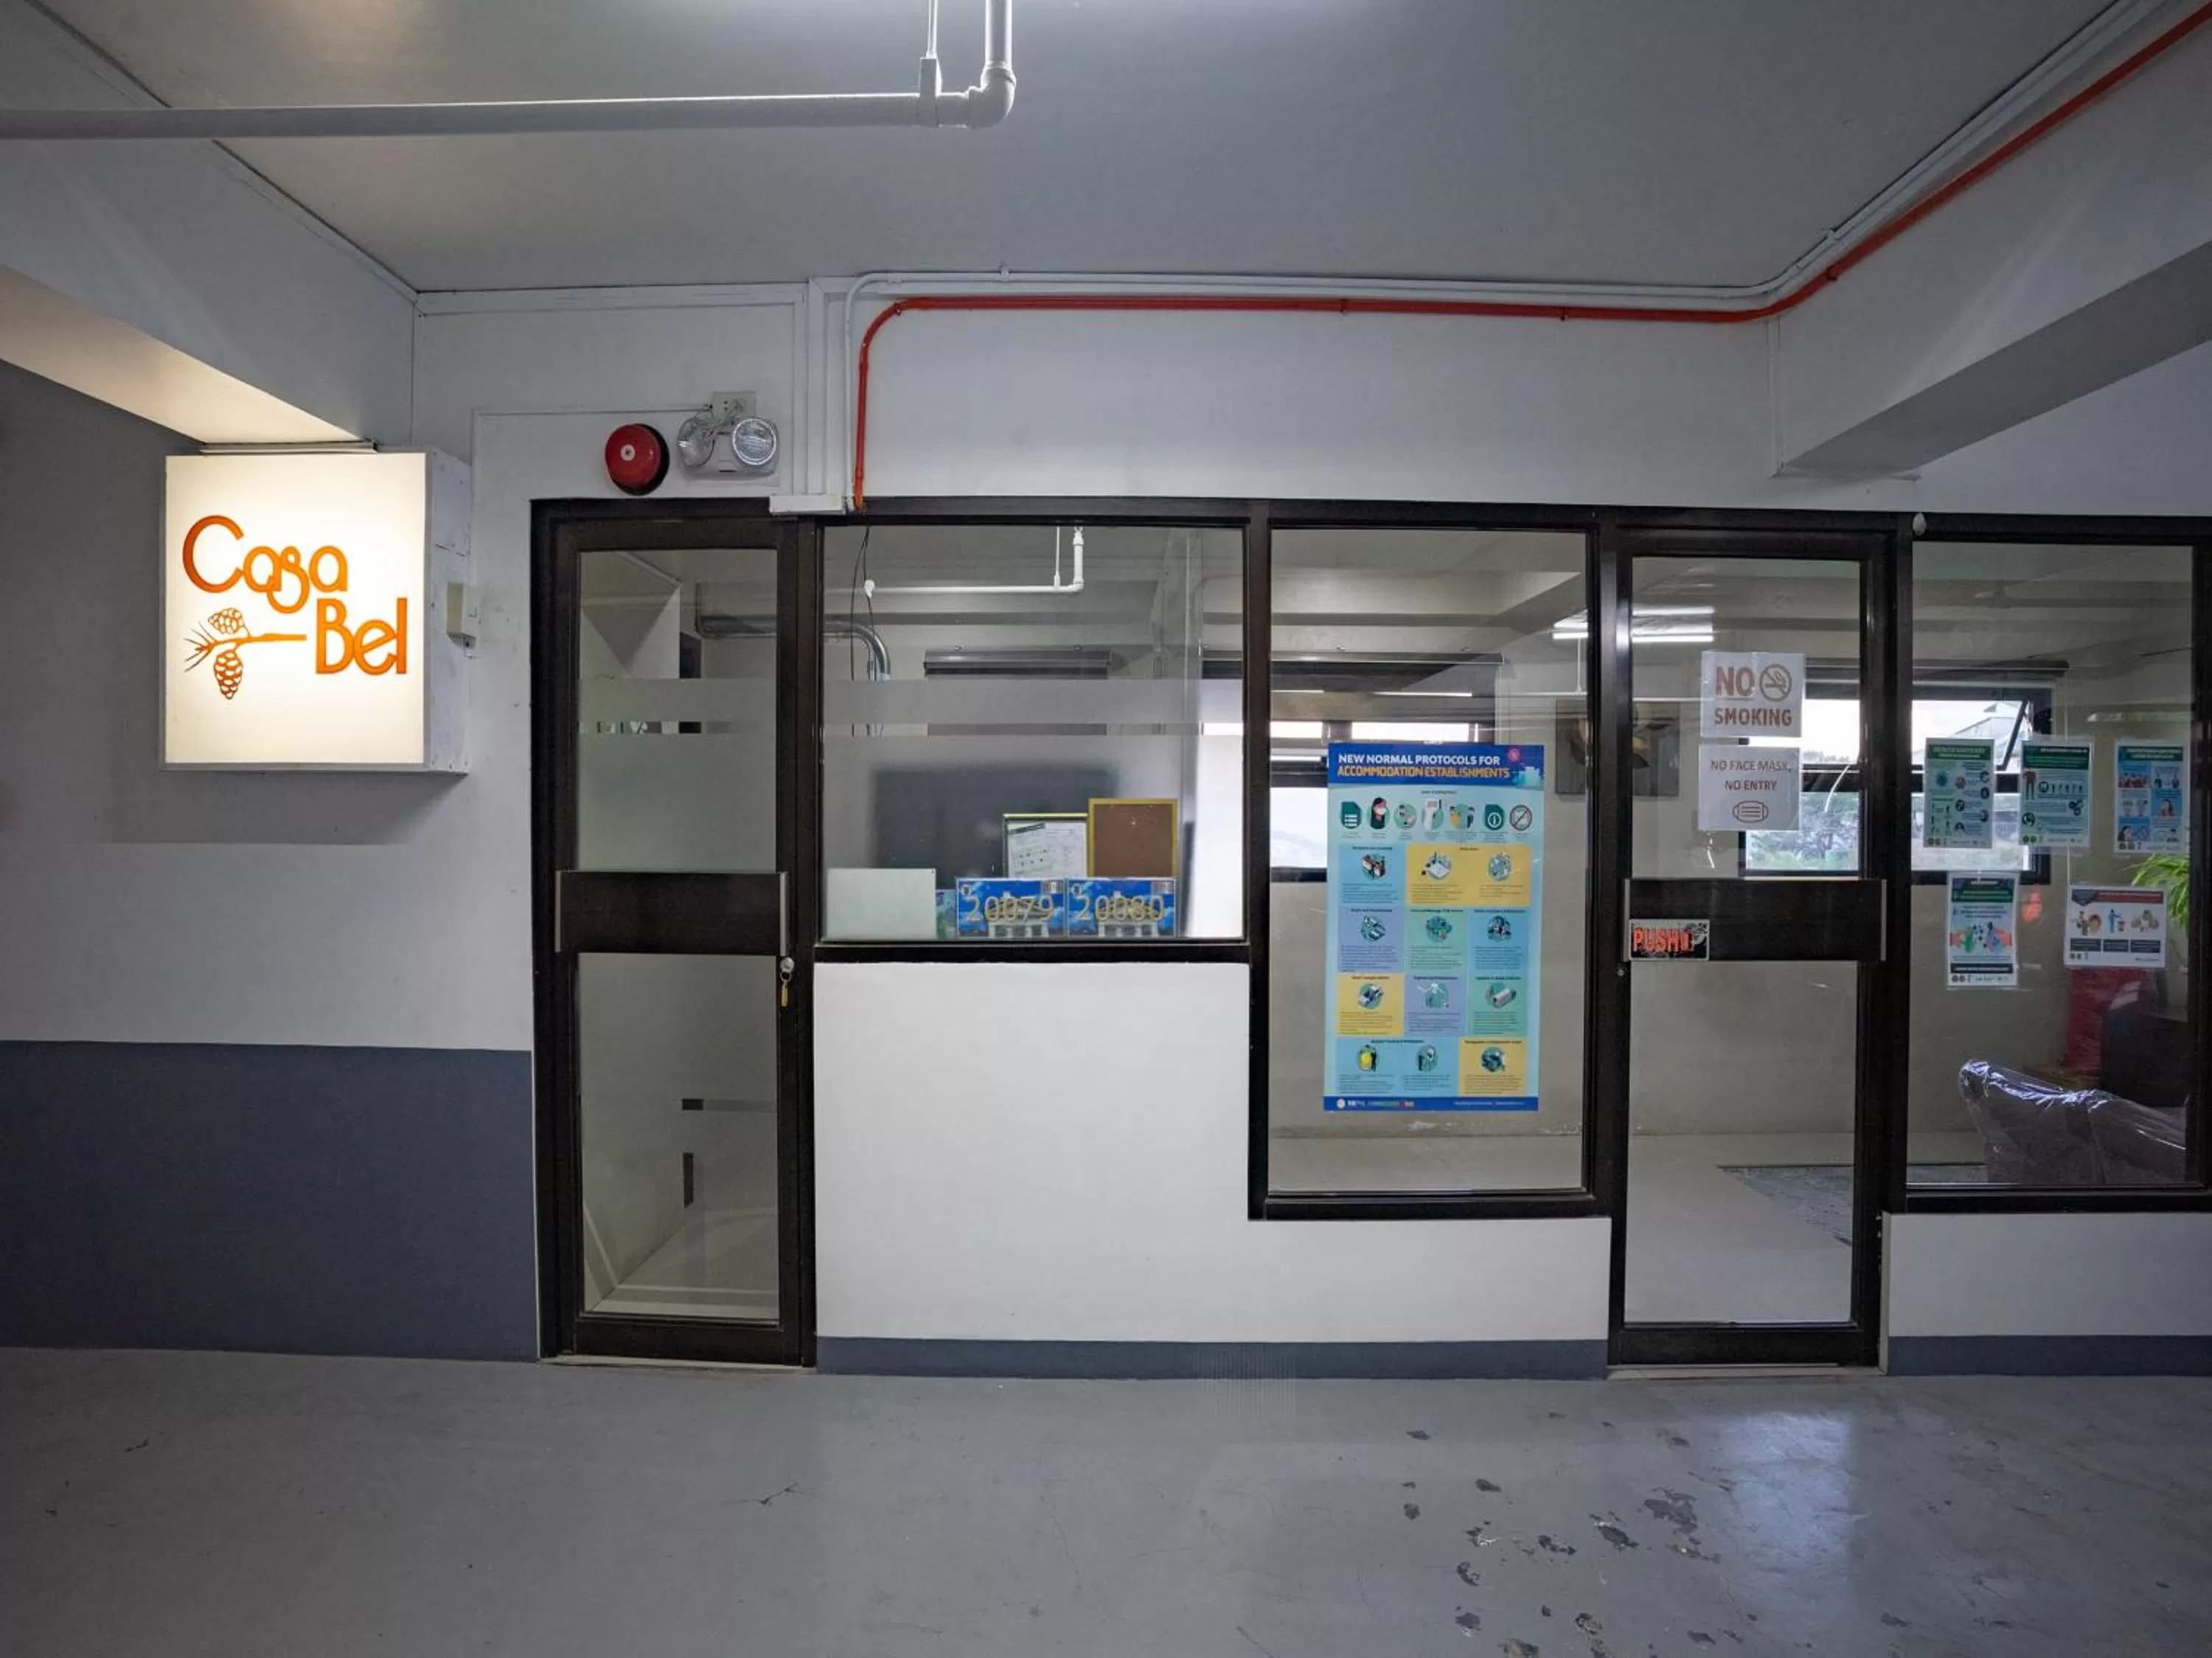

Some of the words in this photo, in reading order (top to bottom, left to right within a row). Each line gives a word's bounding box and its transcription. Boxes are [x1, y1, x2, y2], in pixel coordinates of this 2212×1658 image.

[182, 514, 348, 614] Casa
[316, 597, 408, 676] Bel
[1715, 666, 1755, 697] NO
[1714, 707, 1792, 726] SMOKING
[1338, 754, 1364, 764] NEW
[1366, 755, 1413, 765] NORMAL
[1415, 755, 1476, 766] PROTOCOLS
[1478, 756, 1500, 766] FOR
[1711, 760, 1727, 771] NO
[1729, 760, 1756, 771] FACE
[1338, 766, 1423, 777] ACCOMMODATION
[1425, 767, 1511, 779] ESTABLISHMENTS
[1725, 780, 1741, 791] NO
[1744, 780, 1777, 791] ENTRY
[964, 895, 1054, 922] 20079
